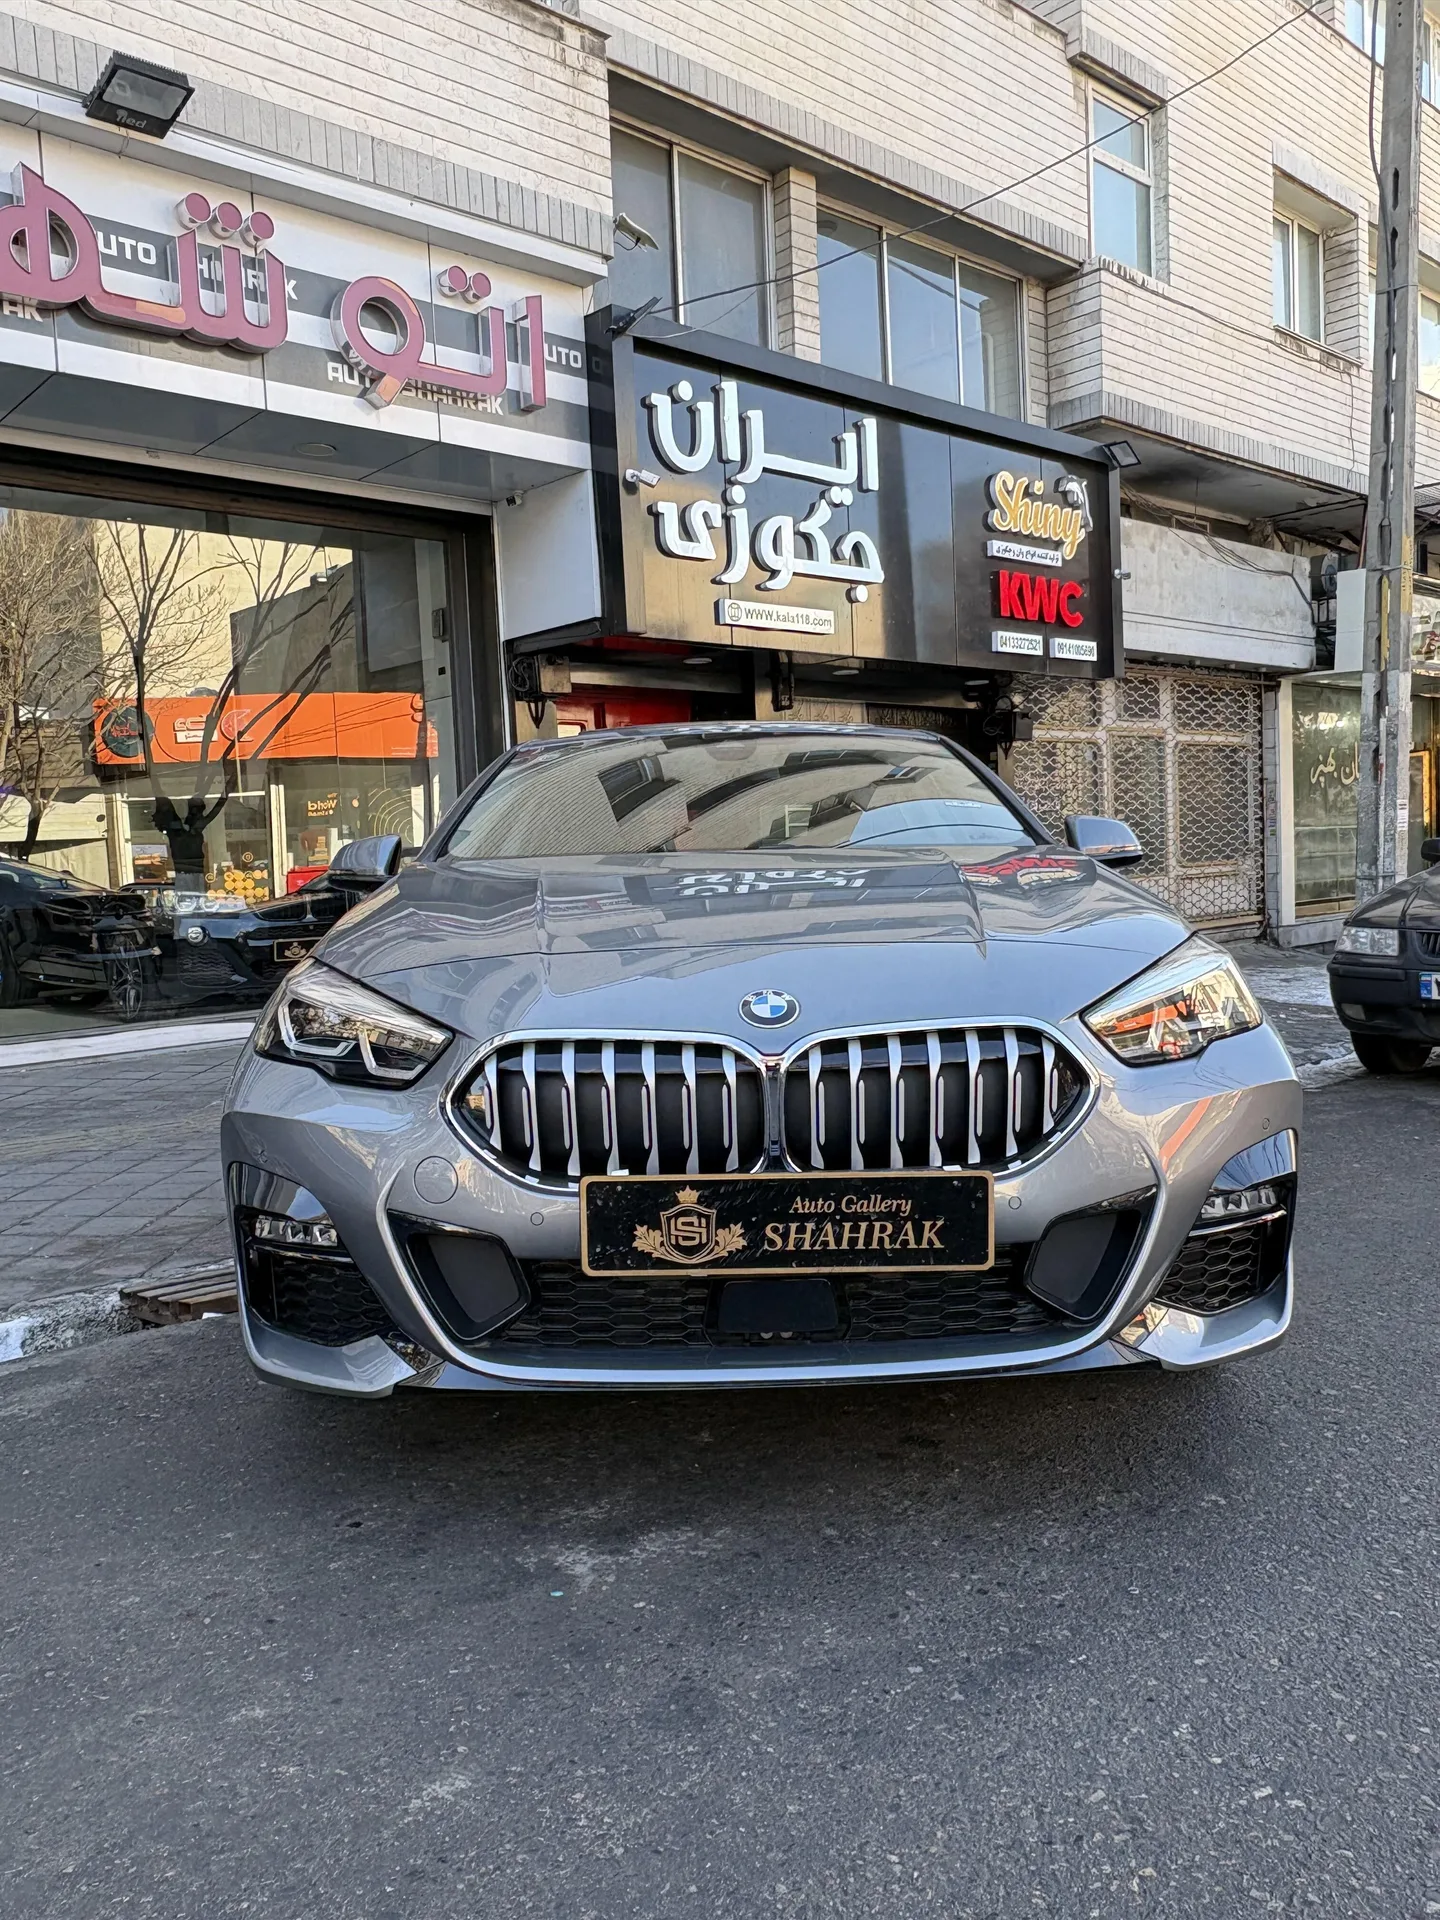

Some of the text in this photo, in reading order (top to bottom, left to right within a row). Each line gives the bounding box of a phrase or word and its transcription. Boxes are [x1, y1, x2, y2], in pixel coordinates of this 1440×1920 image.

[97, 230, 157, 266] UTO
[544, 342, 582, 369] UTO
[640, 380, 880, 506] ایران
[992, 470, 1086, 560] Shiny
[998, 569, 1085, 628] KWC
[789, 1195, 912, 1217] Auto Gallery
[763, 1219, 945, 1252] SHAHRAK
